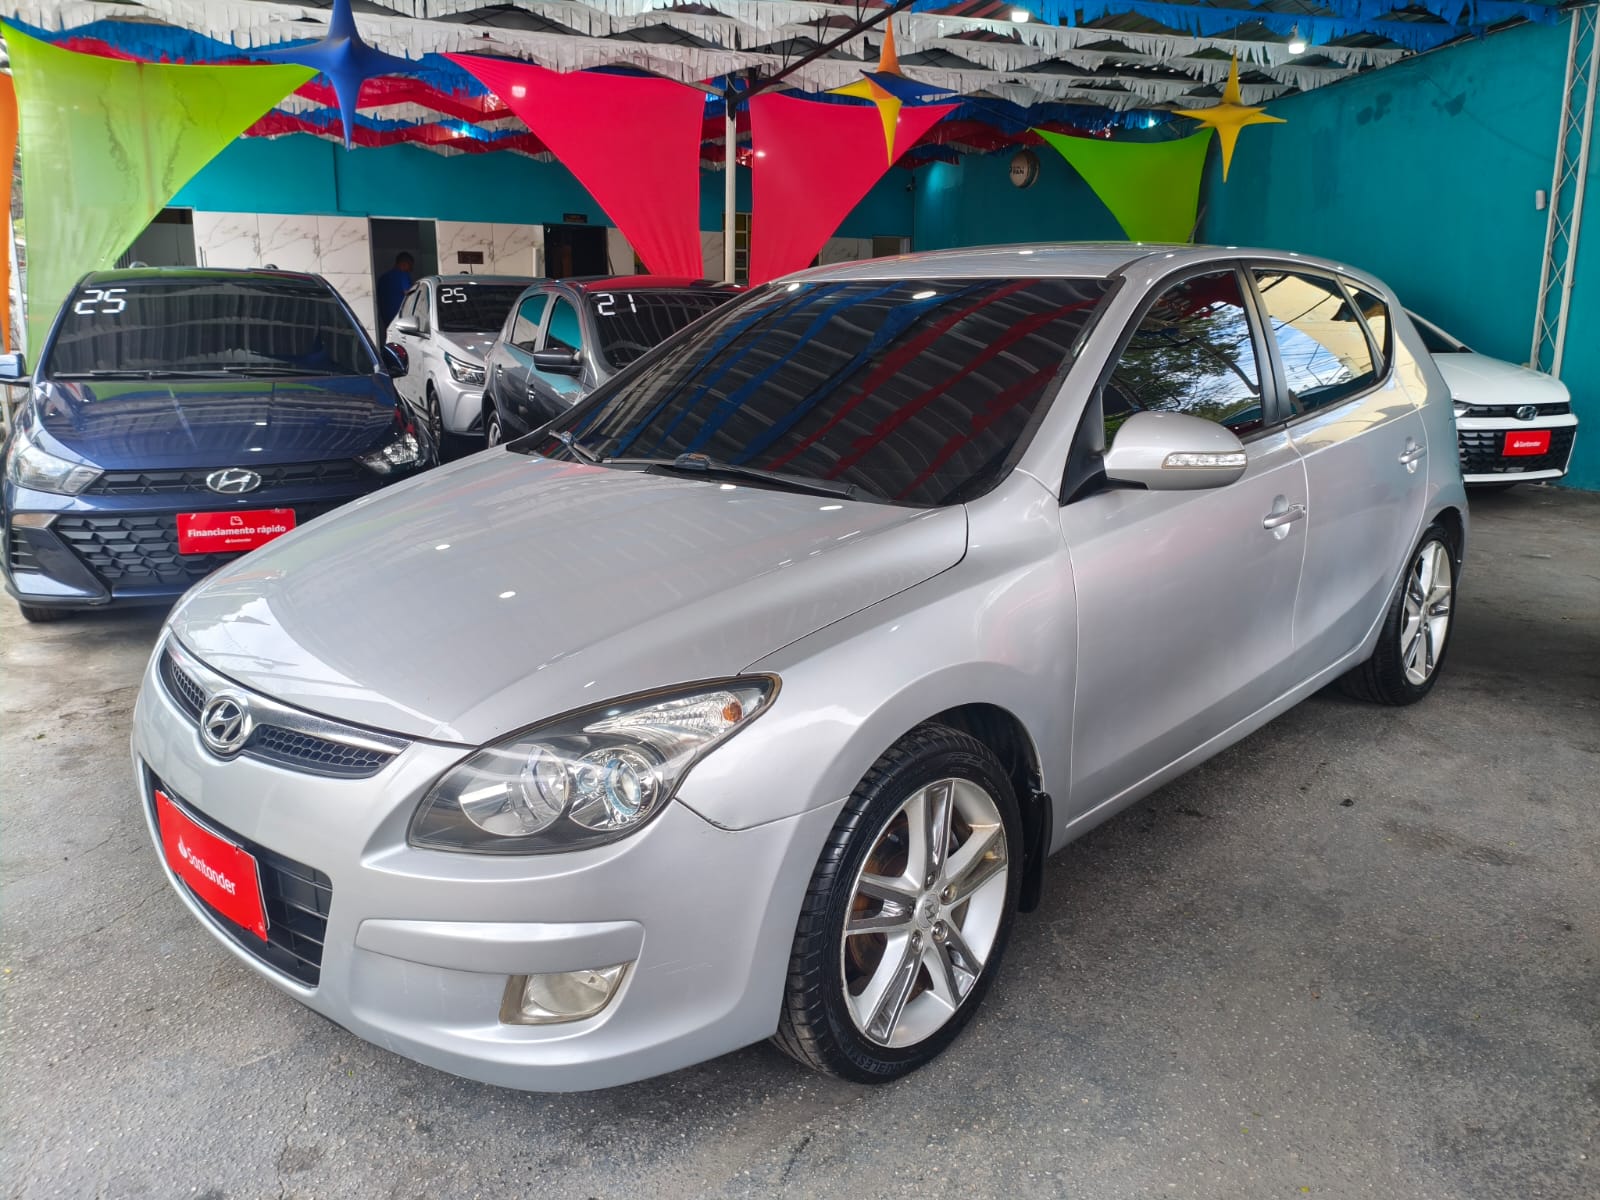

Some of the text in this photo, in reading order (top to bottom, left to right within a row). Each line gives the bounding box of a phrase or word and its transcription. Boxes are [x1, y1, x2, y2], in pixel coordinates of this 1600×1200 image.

[74, 288, 126, 314] 25
[441, 287, 467, 303] 25
[597, 293, 637, 316] 21
[187, 524, 286, 538] Financiamento rápido
[187, 846, 236, 895] Santander
